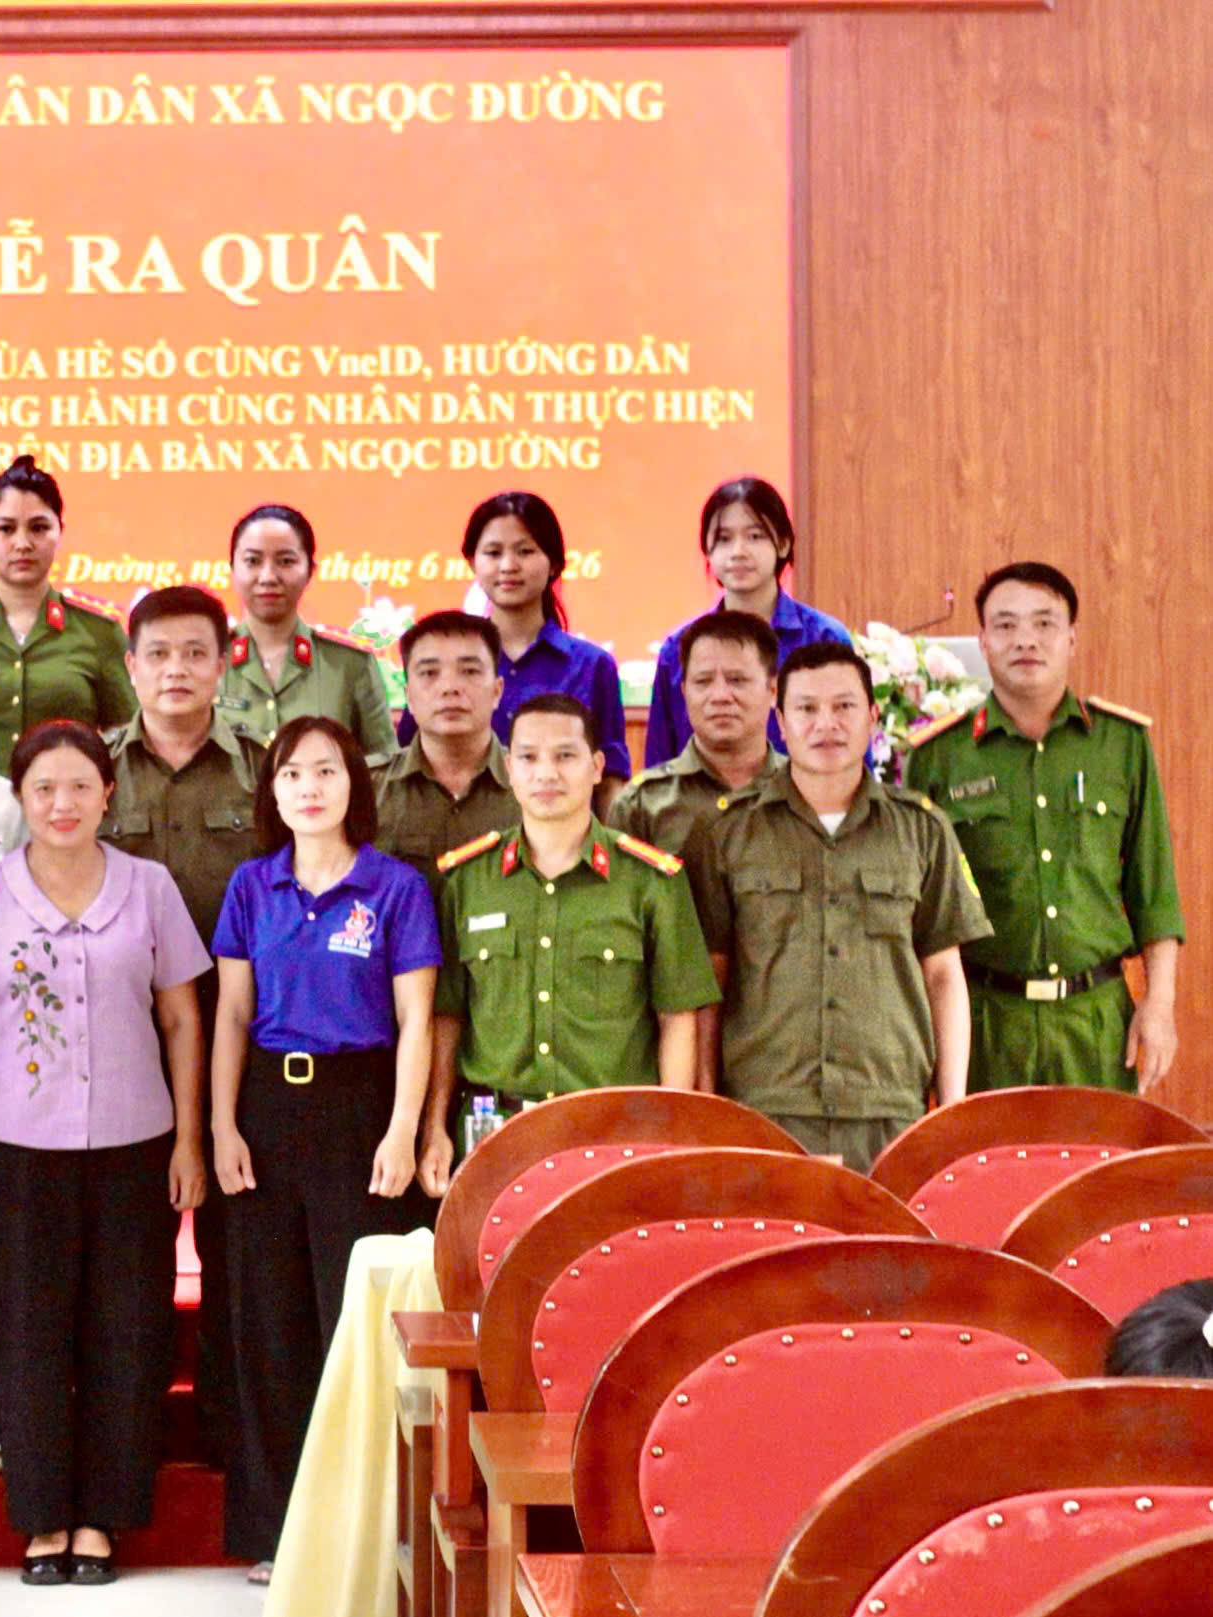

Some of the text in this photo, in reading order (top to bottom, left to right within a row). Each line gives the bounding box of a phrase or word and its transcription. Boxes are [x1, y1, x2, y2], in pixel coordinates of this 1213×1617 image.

[87, 73, 197, 125] DÂN
[210, 75, 286, 124] XÃ
[298, 82, 454, 133] NGỌC
[468, 71, 666, 122] ĐƯỜNG
[66, 234, 187, 294] RA
[201, 213, 442, 306] QUÂN
[56, 338, 115, 379] HÈ
[184, 337, 302, 378] CÙNG
[442, 336, 596, 375] HƯỚNG
[49, 387, 170, 427] HÀNH
[177, 386, 296, 426] CÙNG
[305, 383, 422, 424] NHÂN
[430, 383, 516, 423] DÂN
[525, 386, 646, 430] THỰC
[653, 385, 755, 429] HIỆN
[79, 440, 152, 480] ĐỊA
[160, 432, 244, 471] BÀN
[252, 432, 313, 471] XÃ
[320, 437, 442, 479] NGỌC
[448, 430, 601, 470] ĐƯỜNG
[317, 552, 411, 588] tháng
[417, 551, 440, 580] 6
